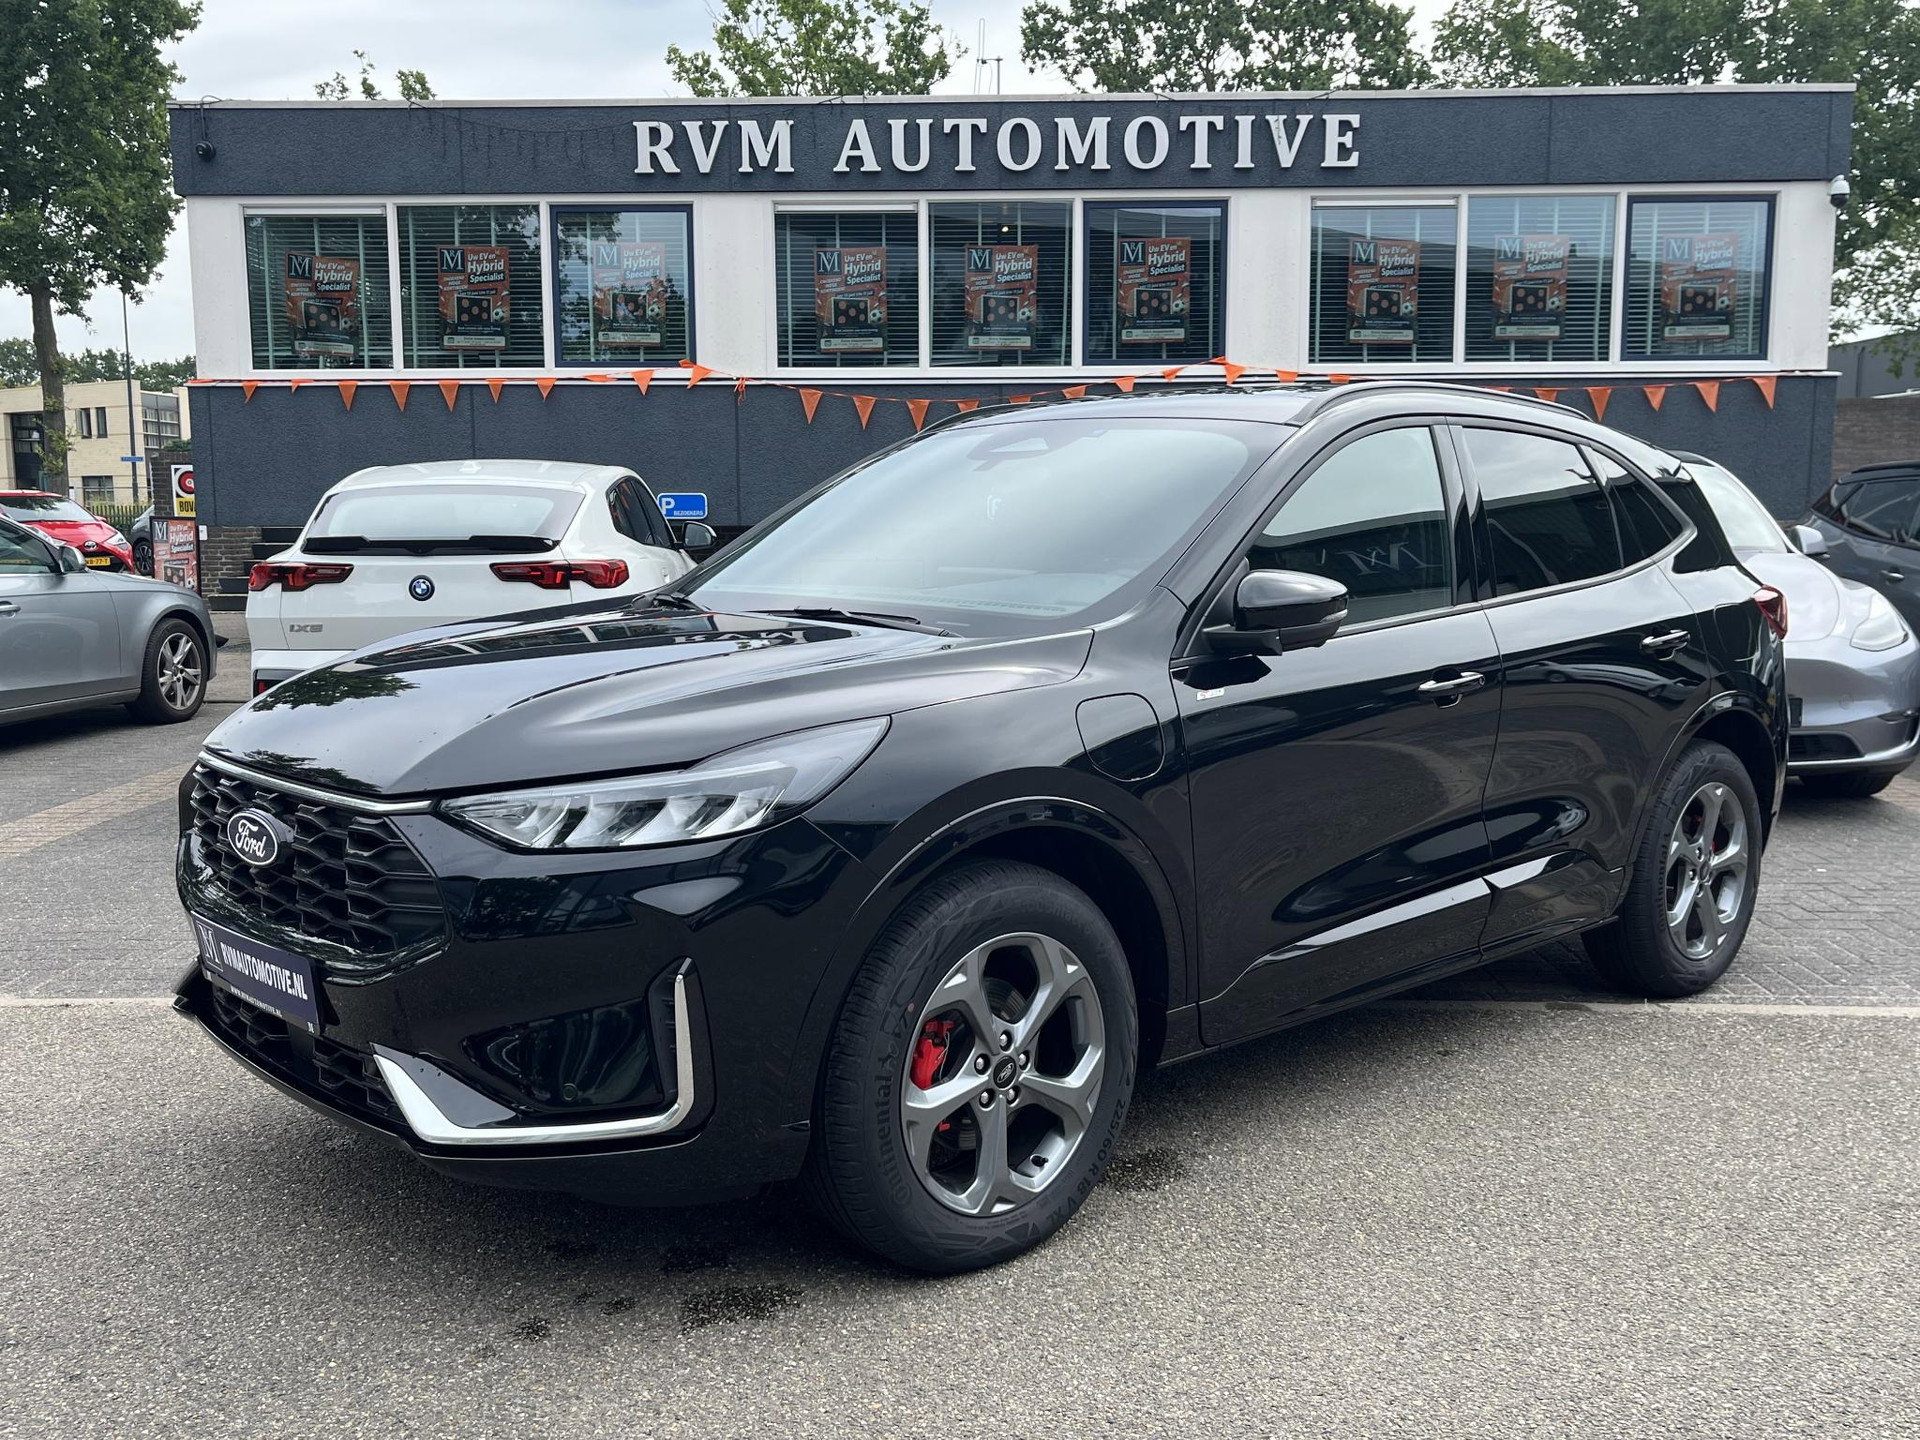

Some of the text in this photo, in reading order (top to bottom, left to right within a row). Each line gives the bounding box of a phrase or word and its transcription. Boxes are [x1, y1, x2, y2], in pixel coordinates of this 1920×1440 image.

[632, 113, 1361, 174] RVM AUTOMOTIVE
[467, 253, 479, 261] Uw
[479, 252, 488, 260] EV
[1148, 245, 1159, 253] Uw
[1525, 247, 1564, 263] Hybrid
[1694, 246, 1734, 263] Hybrid
[623, 256, 660, 272] Hybrid
[995, 258, 1033, 274] Hybrid
[1148, 250, 1186, 267] Hybrid
[1379, 253, 1416, 268] Hybrid
[467, 259, 504, 275] Hybrid
[844, 259, 881, 276] Hybrid
[1149, 264, 1185, 276] Specialist
[1381, 267, 1414, 277] Specialist
[1526, 261, 1563, 272] Specialist
[314, 269, 353, 283] Hybrid
[469, 273, 504, 284] Specialist
[846, 274, 881, 285] Specialist
[997, 272, 1032, 283] Specialist
[316, 282, 351, 292] Specialist
[179, 500, 196, 512] BOV
[661, 497, 675, 515] P
[169, 531, 194, 545] Hybrid
[235, 819, 267, 858] Ford
[220, 941, 308, 1000] RVMAUTOMOTIVE.NL
[1097, 1099, 1127, 1162] 225/60
[1089, 1162, 1099, 1176] R
[1076, 1176, 1093, 1194] 18
